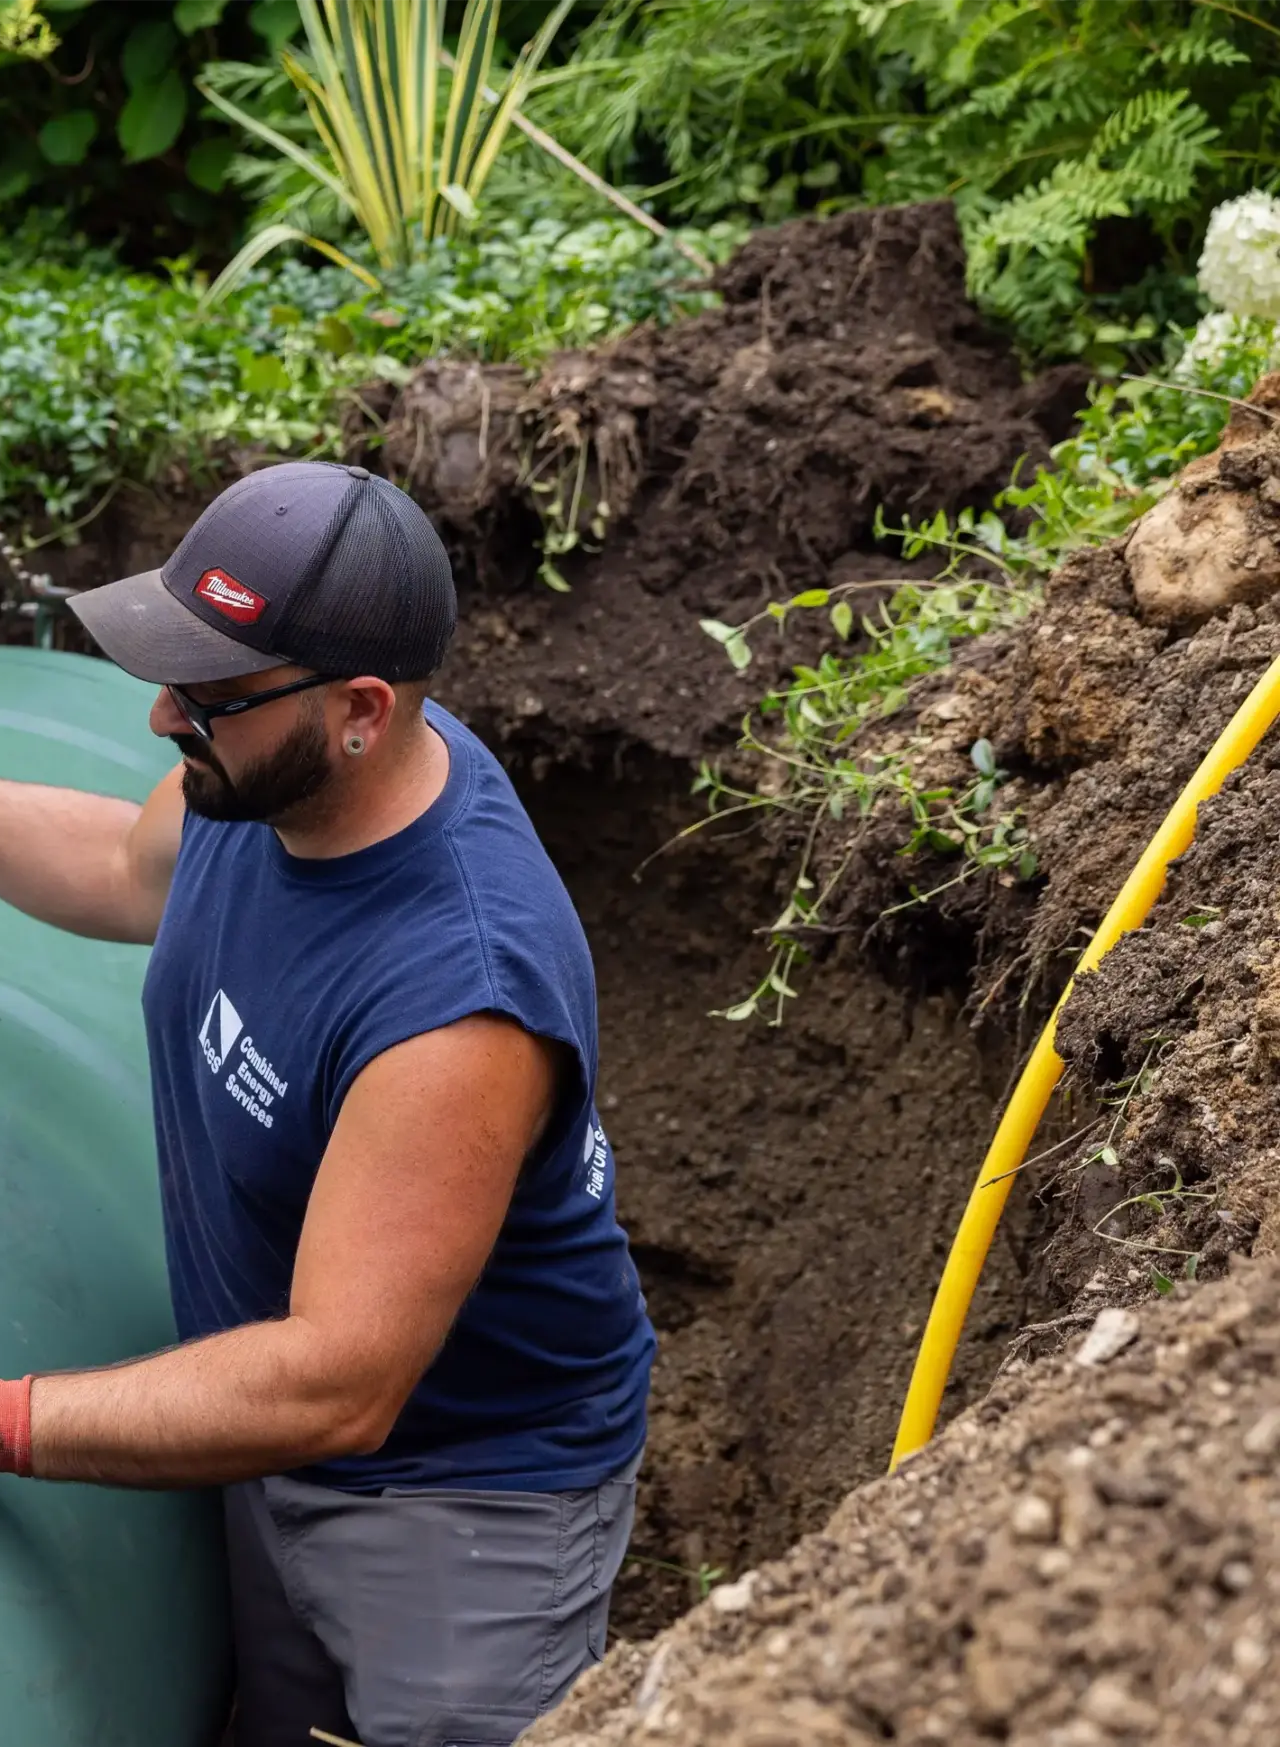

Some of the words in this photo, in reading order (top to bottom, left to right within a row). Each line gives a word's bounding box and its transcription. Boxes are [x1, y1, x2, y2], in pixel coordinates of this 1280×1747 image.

[208, 576, 254, 605] Milwaukee
[237, 1061, 274, 1107] Energy
[240, 1036, 288, 1098] Combined
[225, 1074, 274, 1129] Services
[586, 1166, 605, 1200] Fuel
